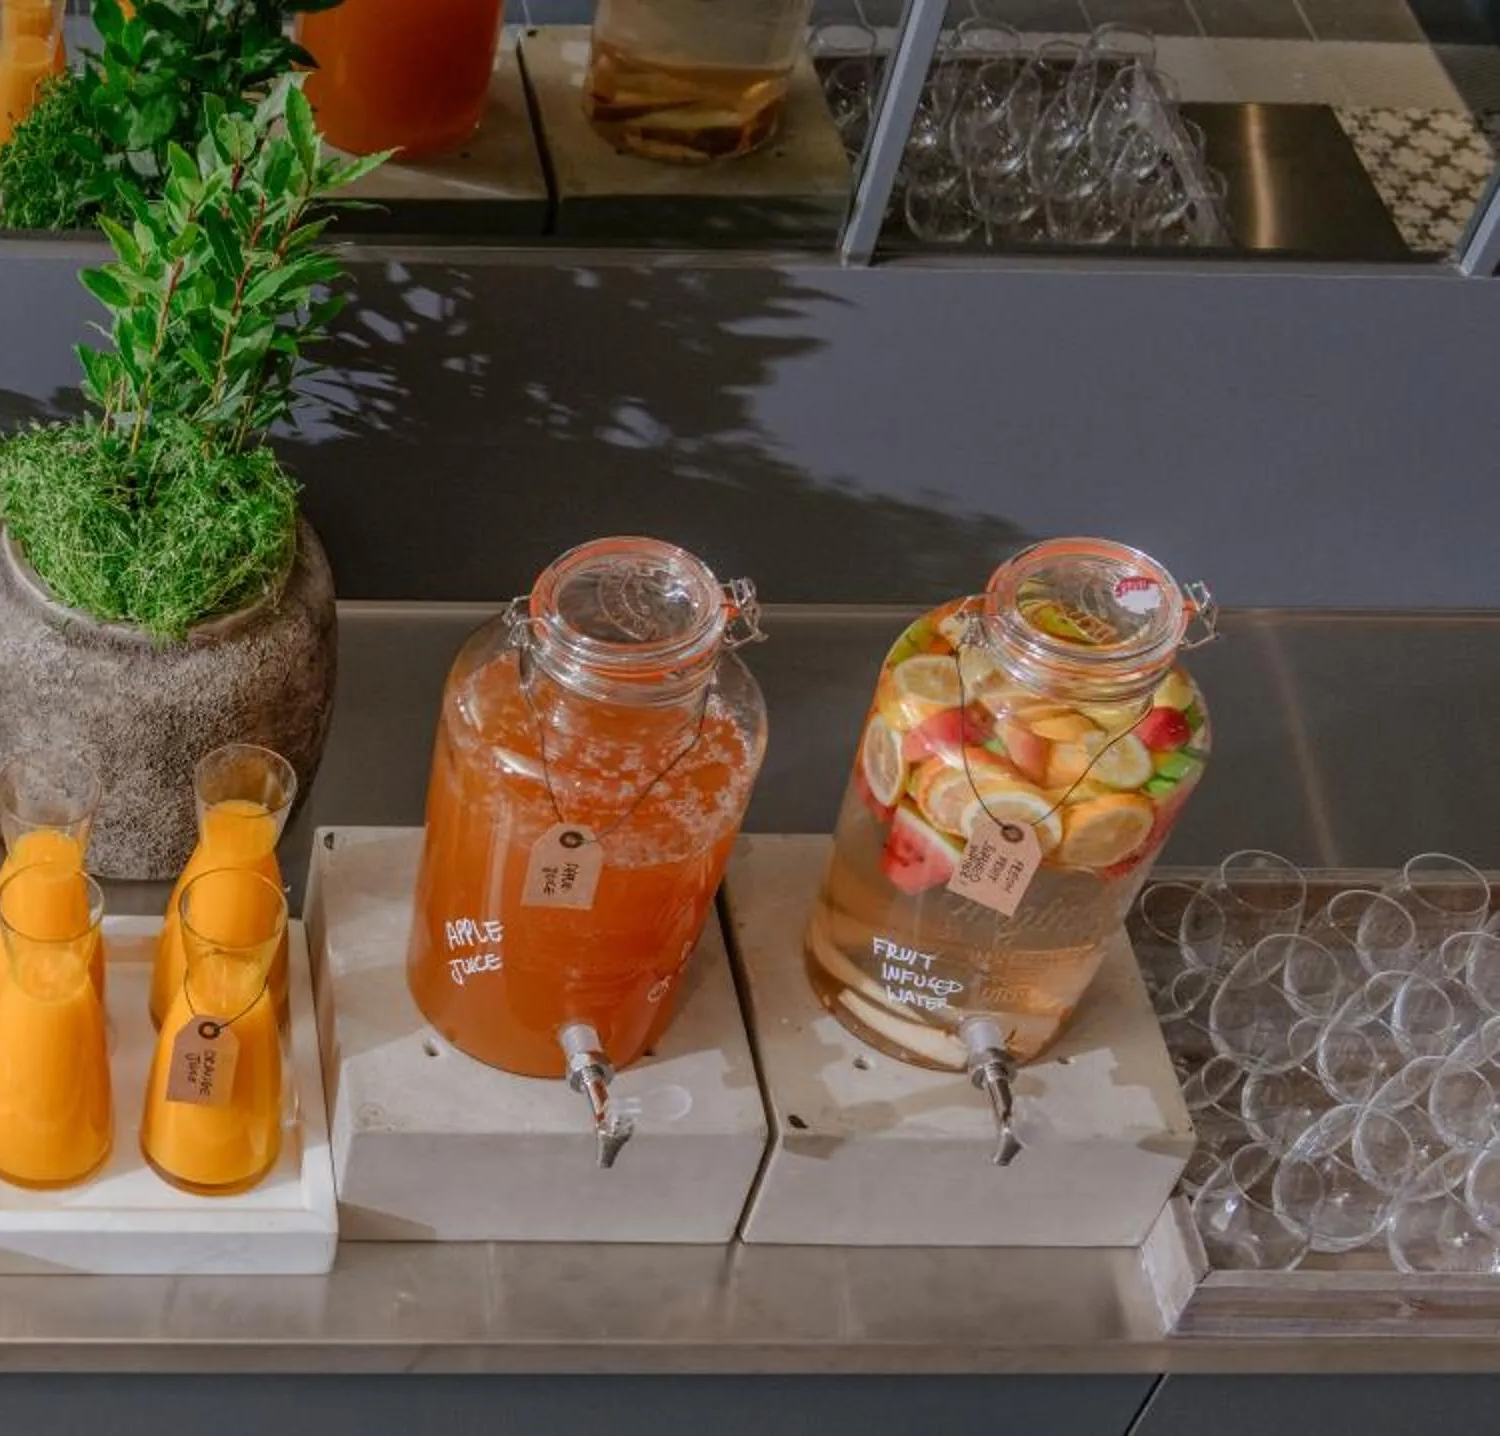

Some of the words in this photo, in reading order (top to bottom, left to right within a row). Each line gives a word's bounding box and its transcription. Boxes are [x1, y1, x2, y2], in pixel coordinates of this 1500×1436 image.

[445, 917, 504, 951] APPLE
[447, 953, 503, 985] JUICE
[873, 937, 937, 970] FRUIT
[881, 962, 964, 995] INFUSED
[885, 985, 950, 1011] WATER
